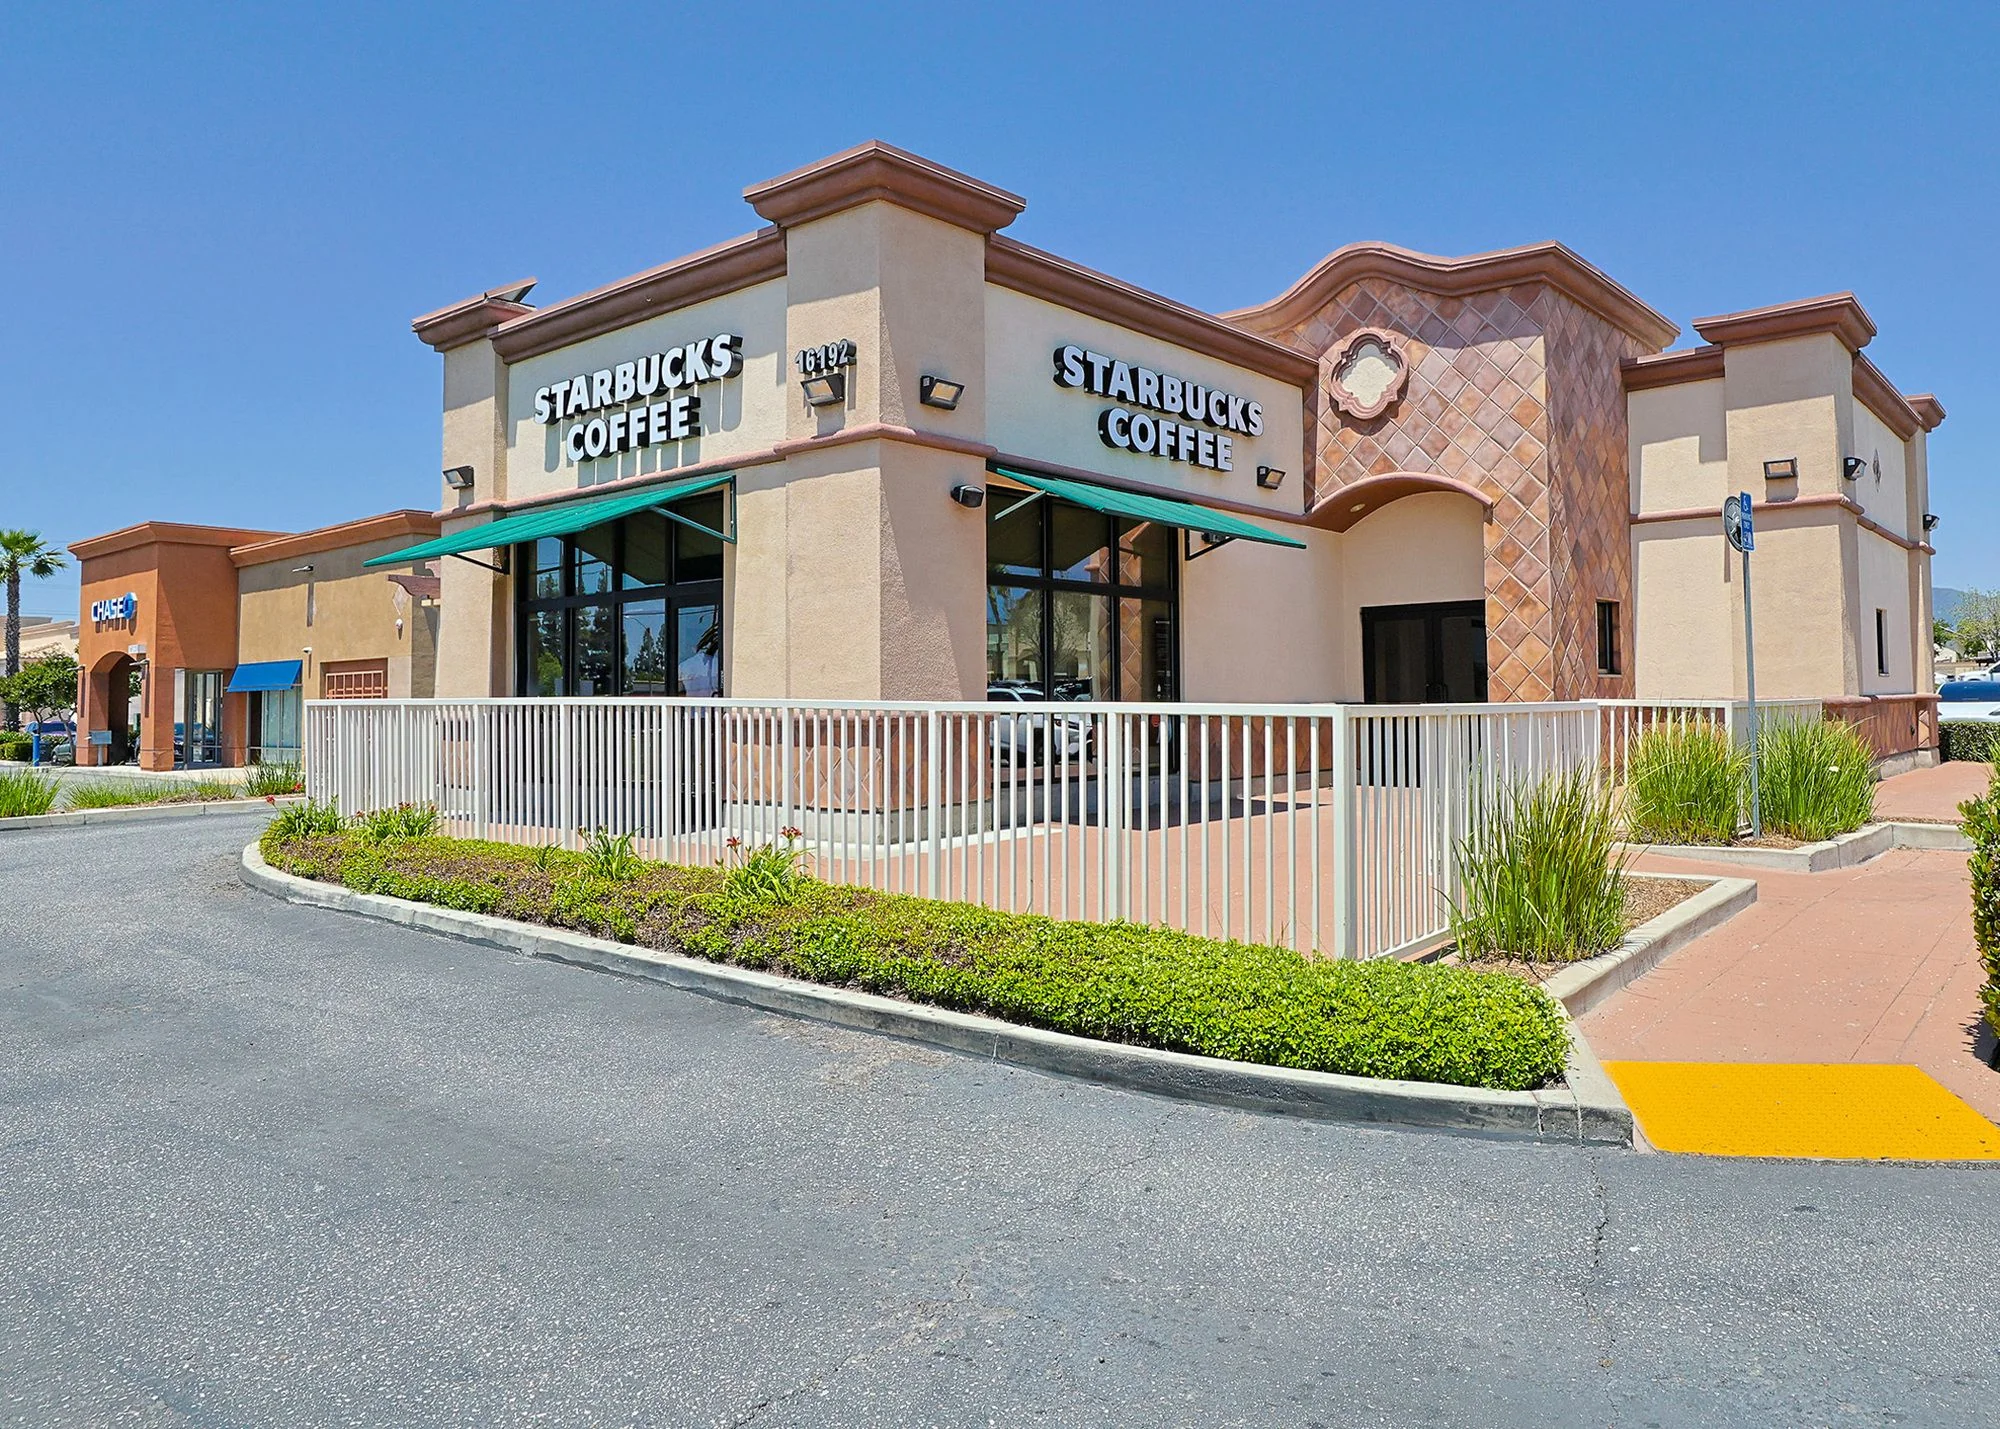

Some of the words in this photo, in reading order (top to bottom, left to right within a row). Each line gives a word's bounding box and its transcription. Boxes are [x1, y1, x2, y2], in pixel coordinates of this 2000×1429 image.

[533, 334, 735, 425] STARBUCKS
[795, 338, 849, 373] 16192
[1062, 345, 1264, 437] STARBUCKS
[567, 398, 691, 462] COFFEE
[1108, 407, 1233, 472] COFFEE
[91, 596, 126, 622] CHASE
